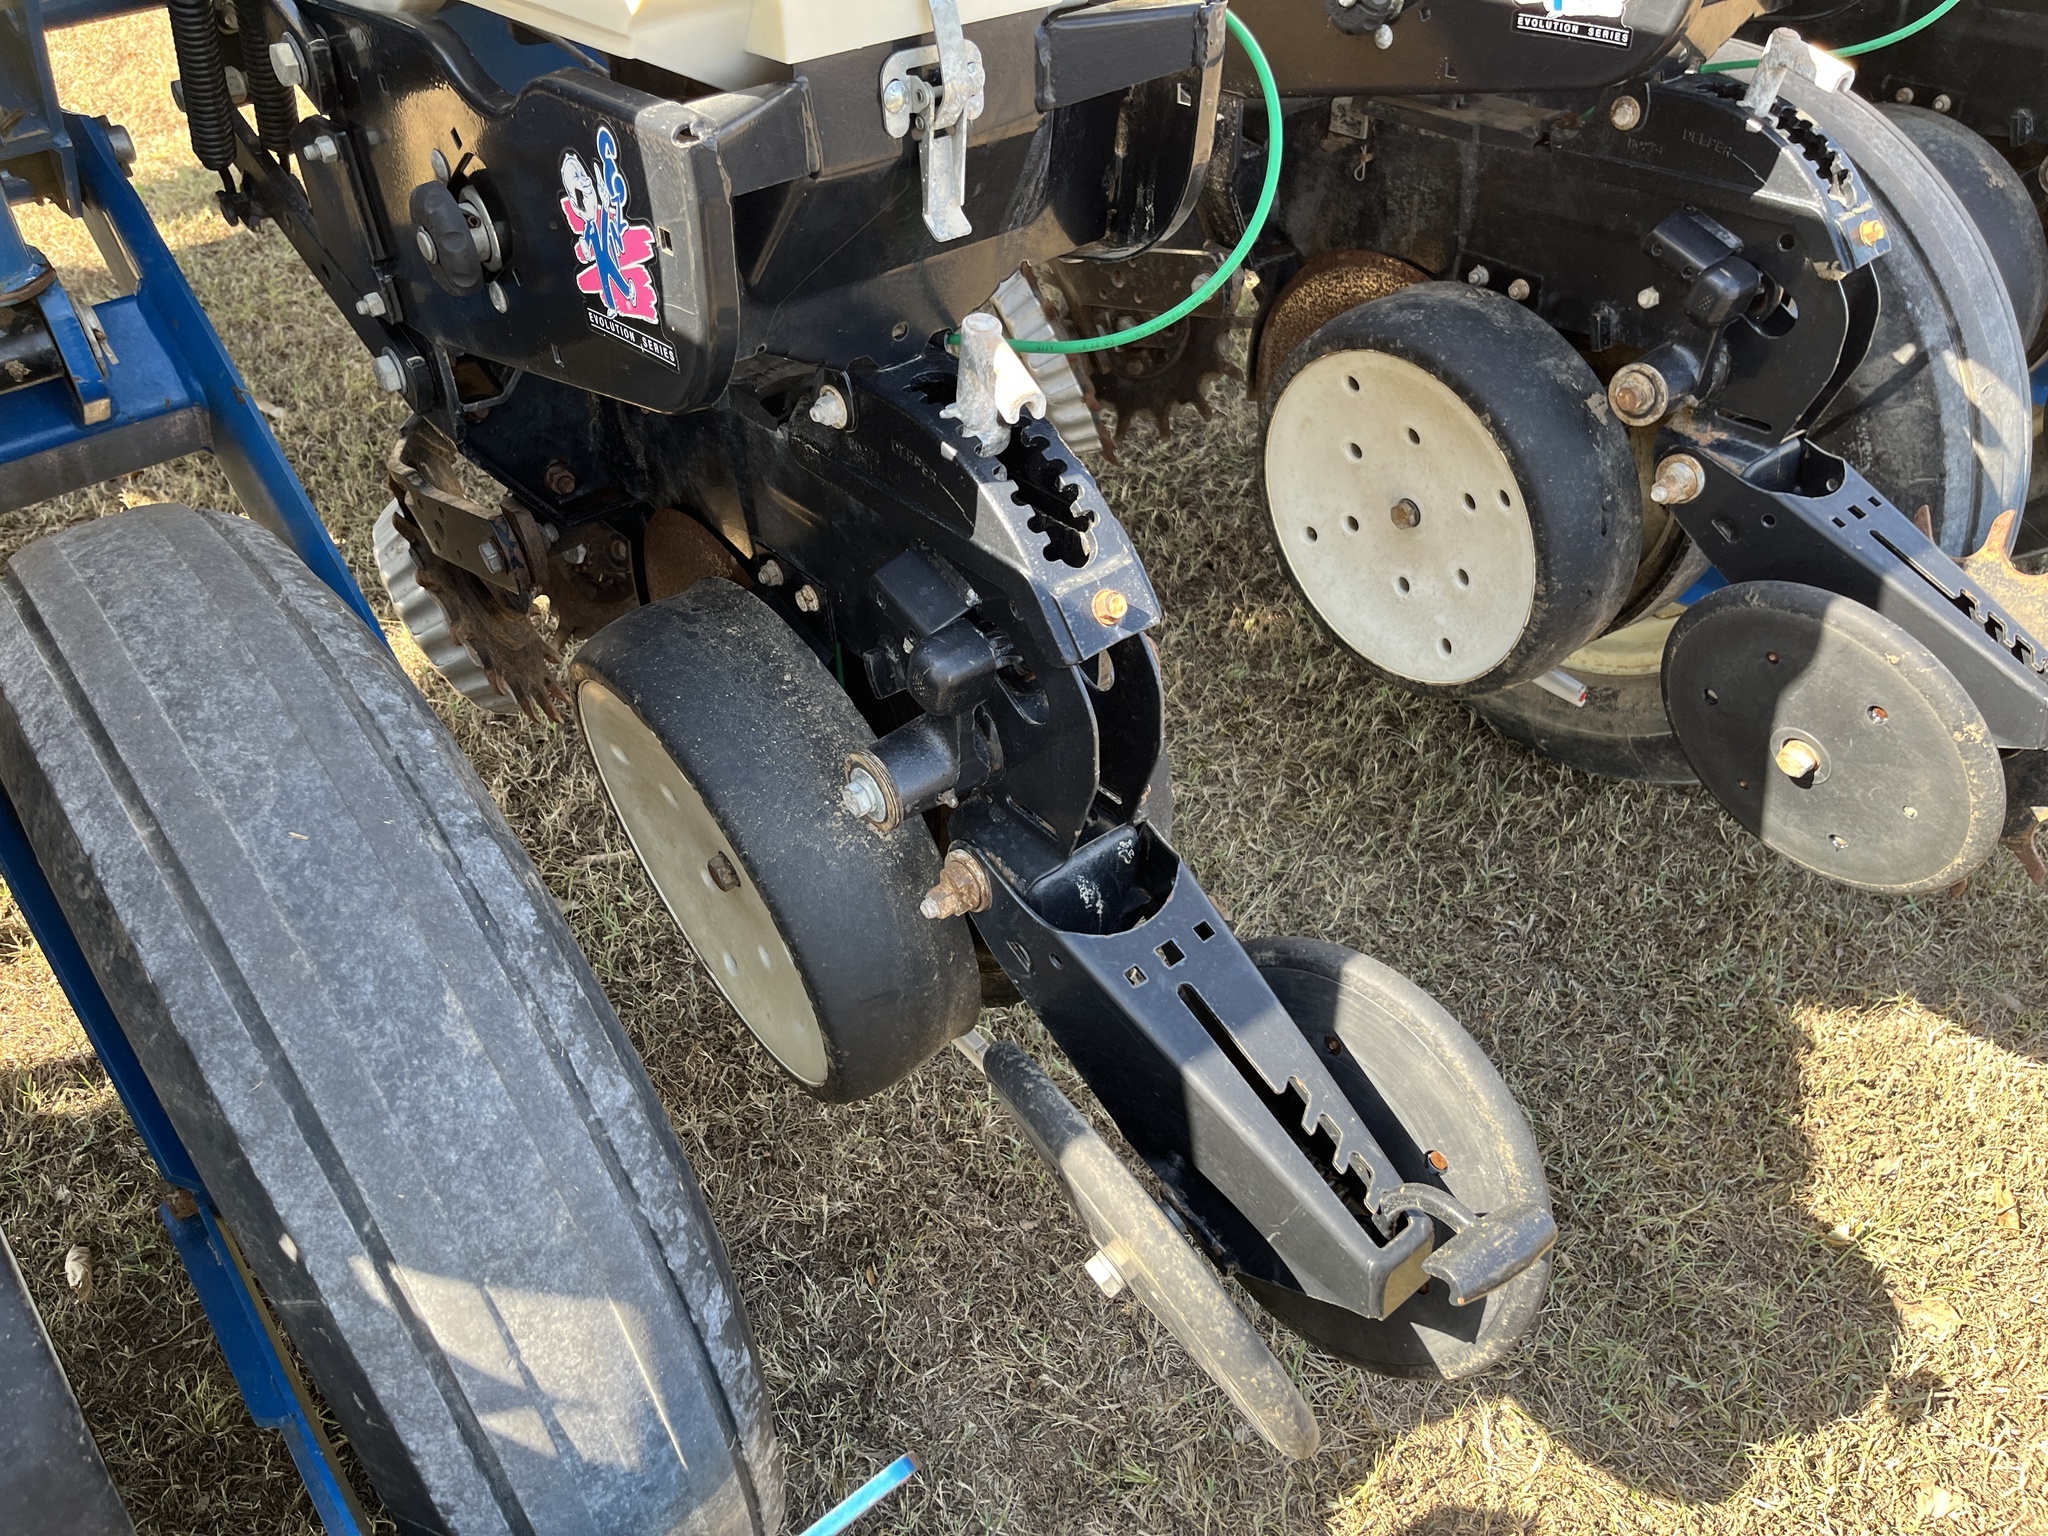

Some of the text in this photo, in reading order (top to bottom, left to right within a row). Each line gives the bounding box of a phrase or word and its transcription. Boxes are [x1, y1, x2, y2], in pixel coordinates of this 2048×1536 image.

[1517, 16, 1629, 43] EVOLUTION SERIES
[588, 311, 676, 362] EVOLUTION SERIES
